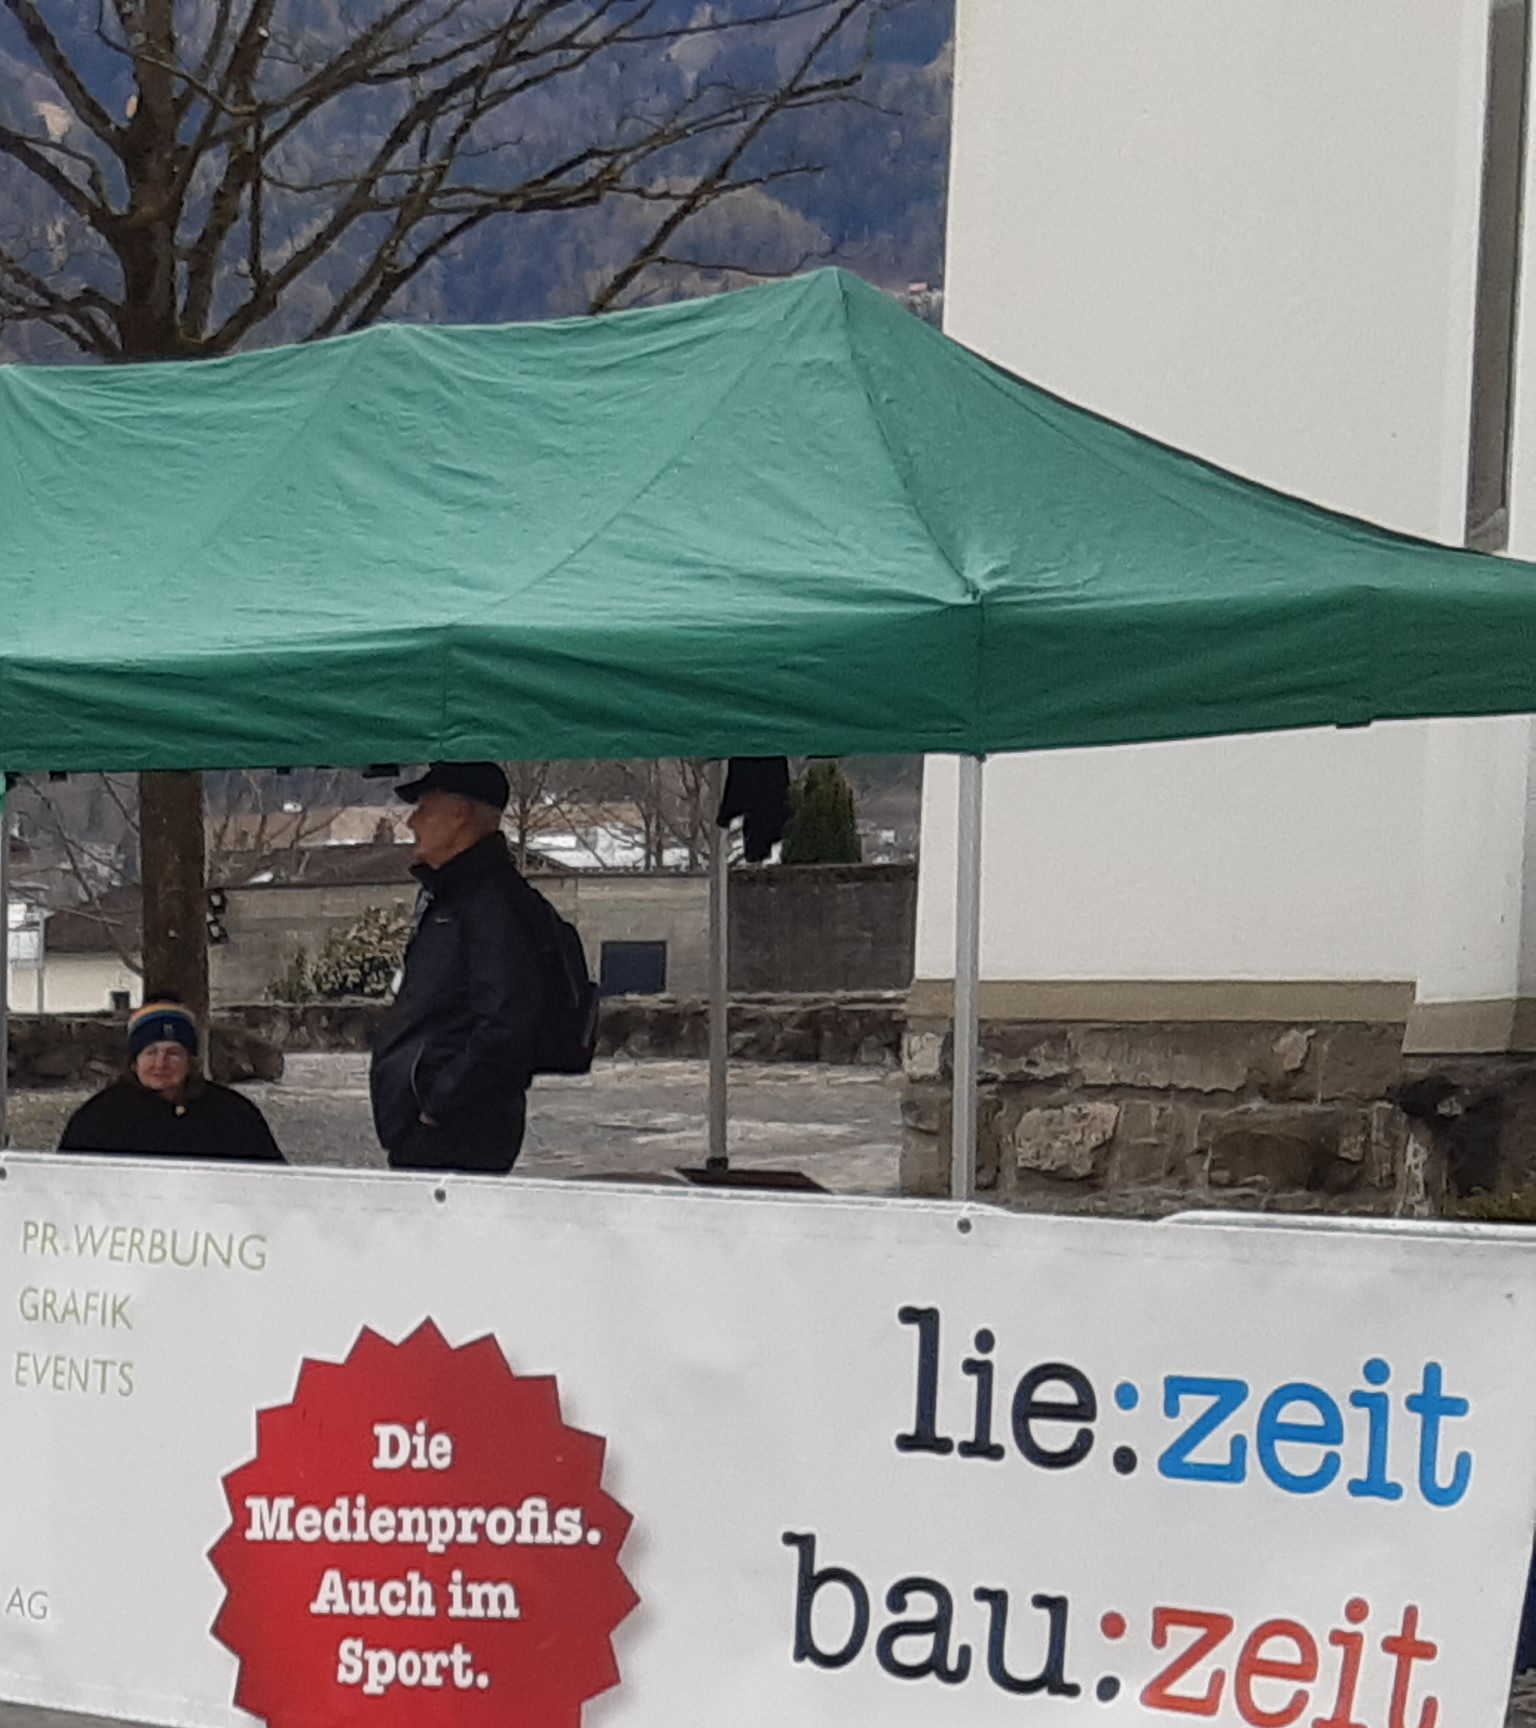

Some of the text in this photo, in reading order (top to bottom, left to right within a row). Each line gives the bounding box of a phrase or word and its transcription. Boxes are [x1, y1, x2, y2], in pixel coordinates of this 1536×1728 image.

[19, 1285, 134, 1330] GRAFIK
[14, 1351, 135, 1397] EVENTS
[894, 1305, 1473, 1508] lie:zeit
[372, 1419, 454, 1470] Die
[244, 1492, 603, 1554] Medienprofis.
[5, 1586, 49, 1621] AG
[309, 1568, 521, 1619] Auch im
[336, 1637, 491, 1695] Sport.
